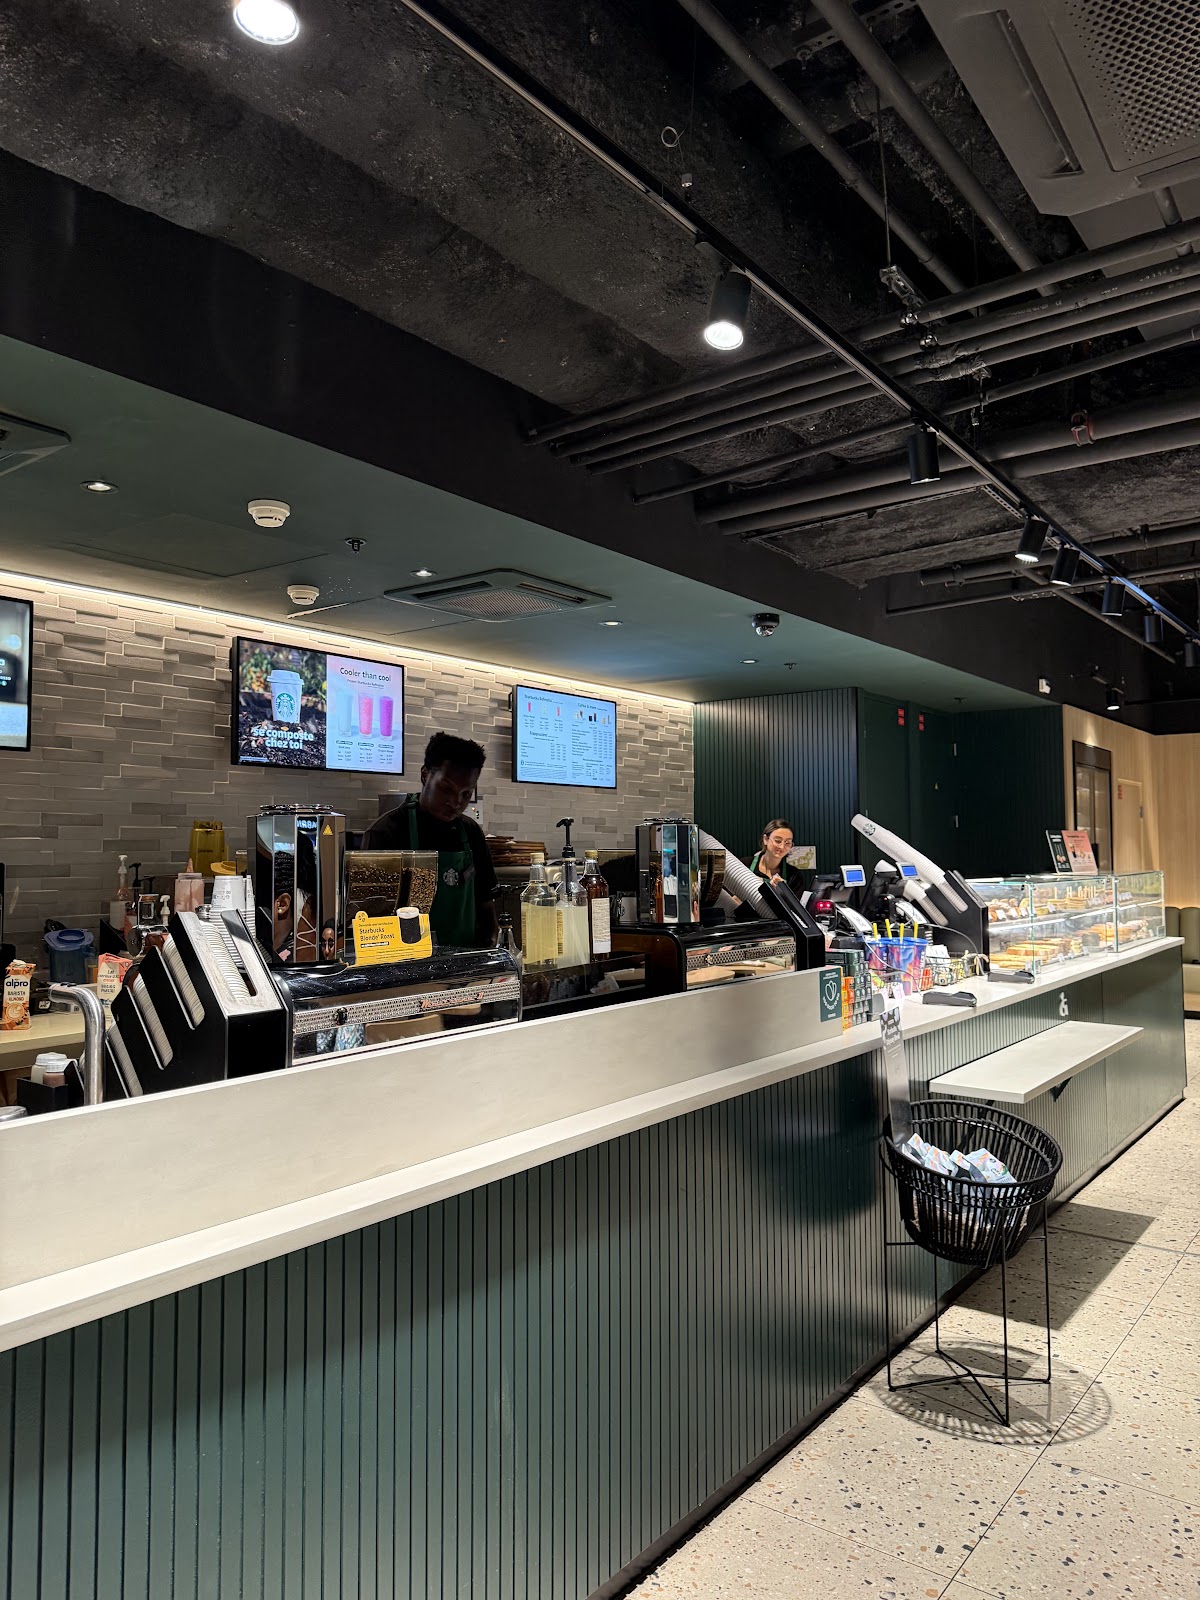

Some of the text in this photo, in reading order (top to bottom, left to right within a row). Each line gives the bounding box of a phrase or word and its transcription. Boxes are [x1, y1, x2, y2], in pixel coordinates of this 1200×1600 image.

[340, 667, 361, 677] Cooler
[362, 671, 377, 680] than
[253, 728, 314, 742] se composte
[265, 737, 303, 750] chez toi
[359, 927, 385, 935] Starbucks
[6, 979, 28, 988] alpro
